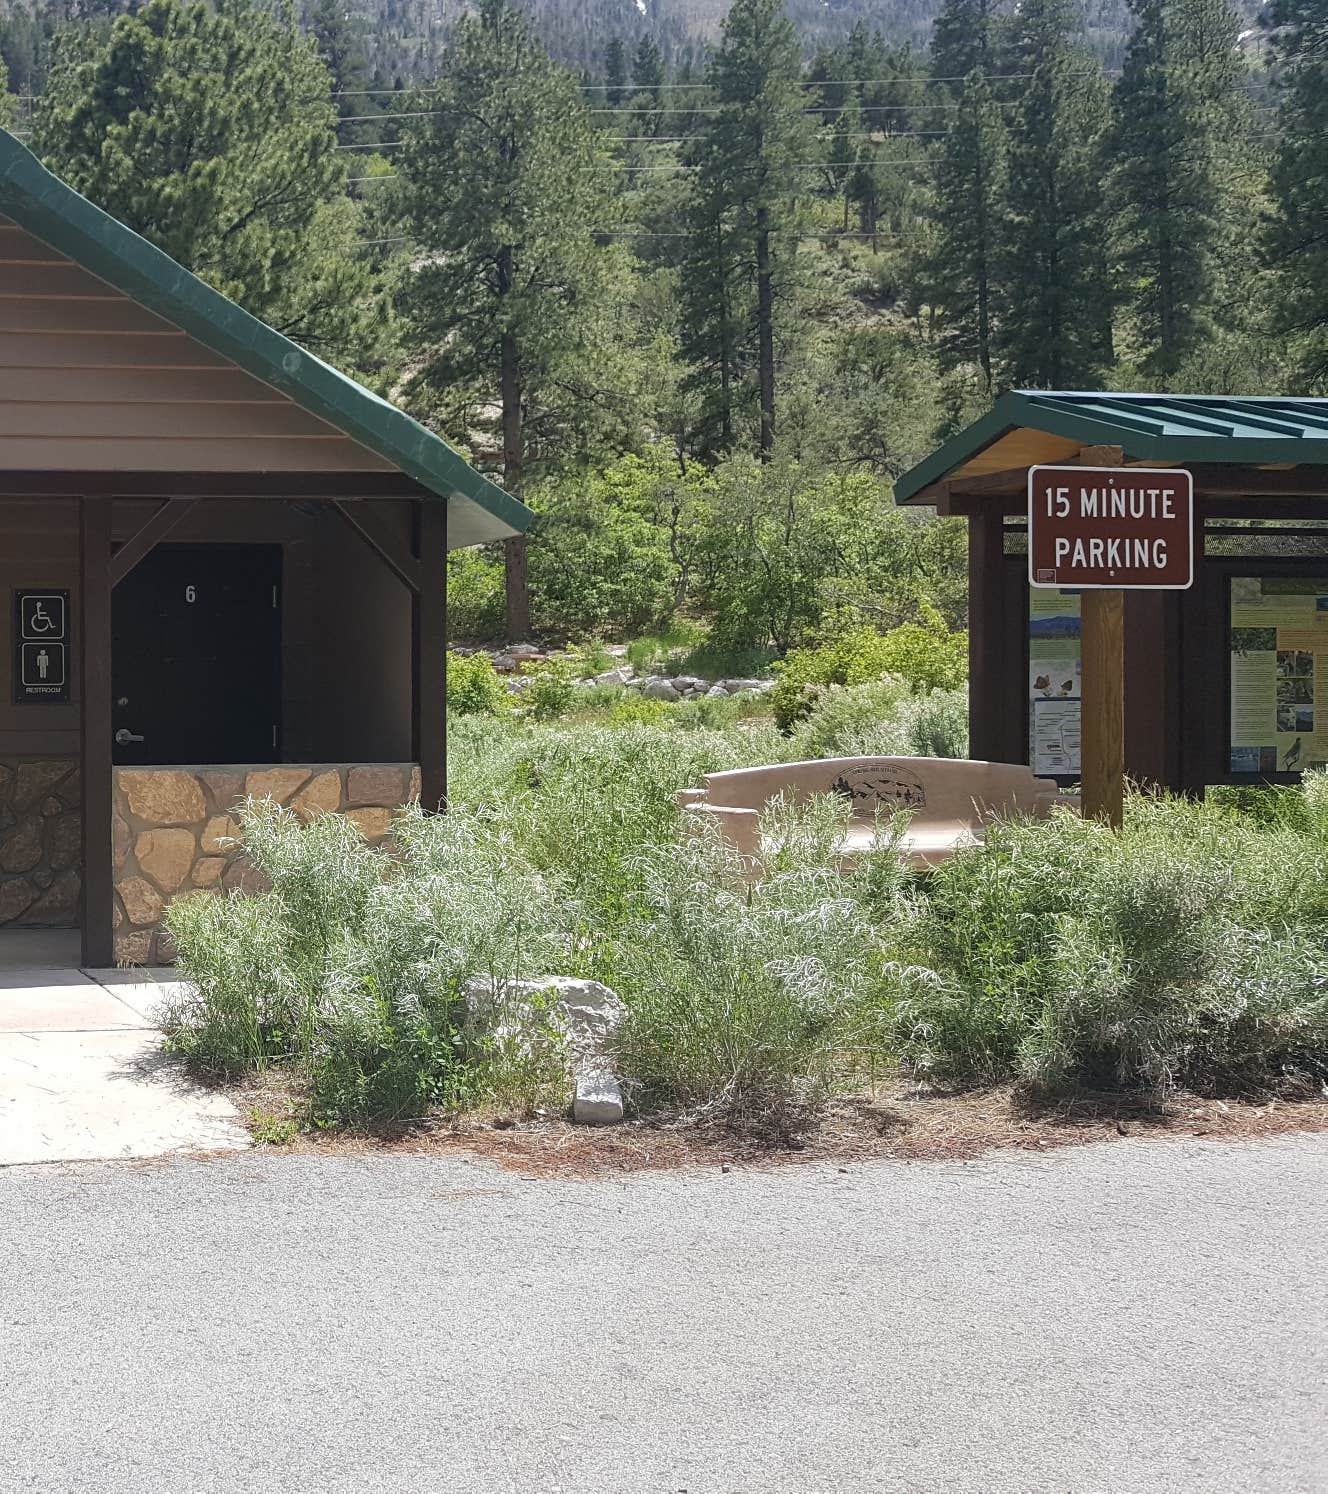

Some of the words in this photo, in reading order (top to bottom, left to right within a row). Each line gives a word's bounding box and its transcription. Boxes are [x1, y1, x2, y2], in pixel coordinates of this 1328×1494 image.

[1045, 487, 1071, 518] 15
[1080, 487, 1176, 519] MINUTE
[1055, 537, 1168, 569] PARKING
[185, 585, 196, 603] 6
